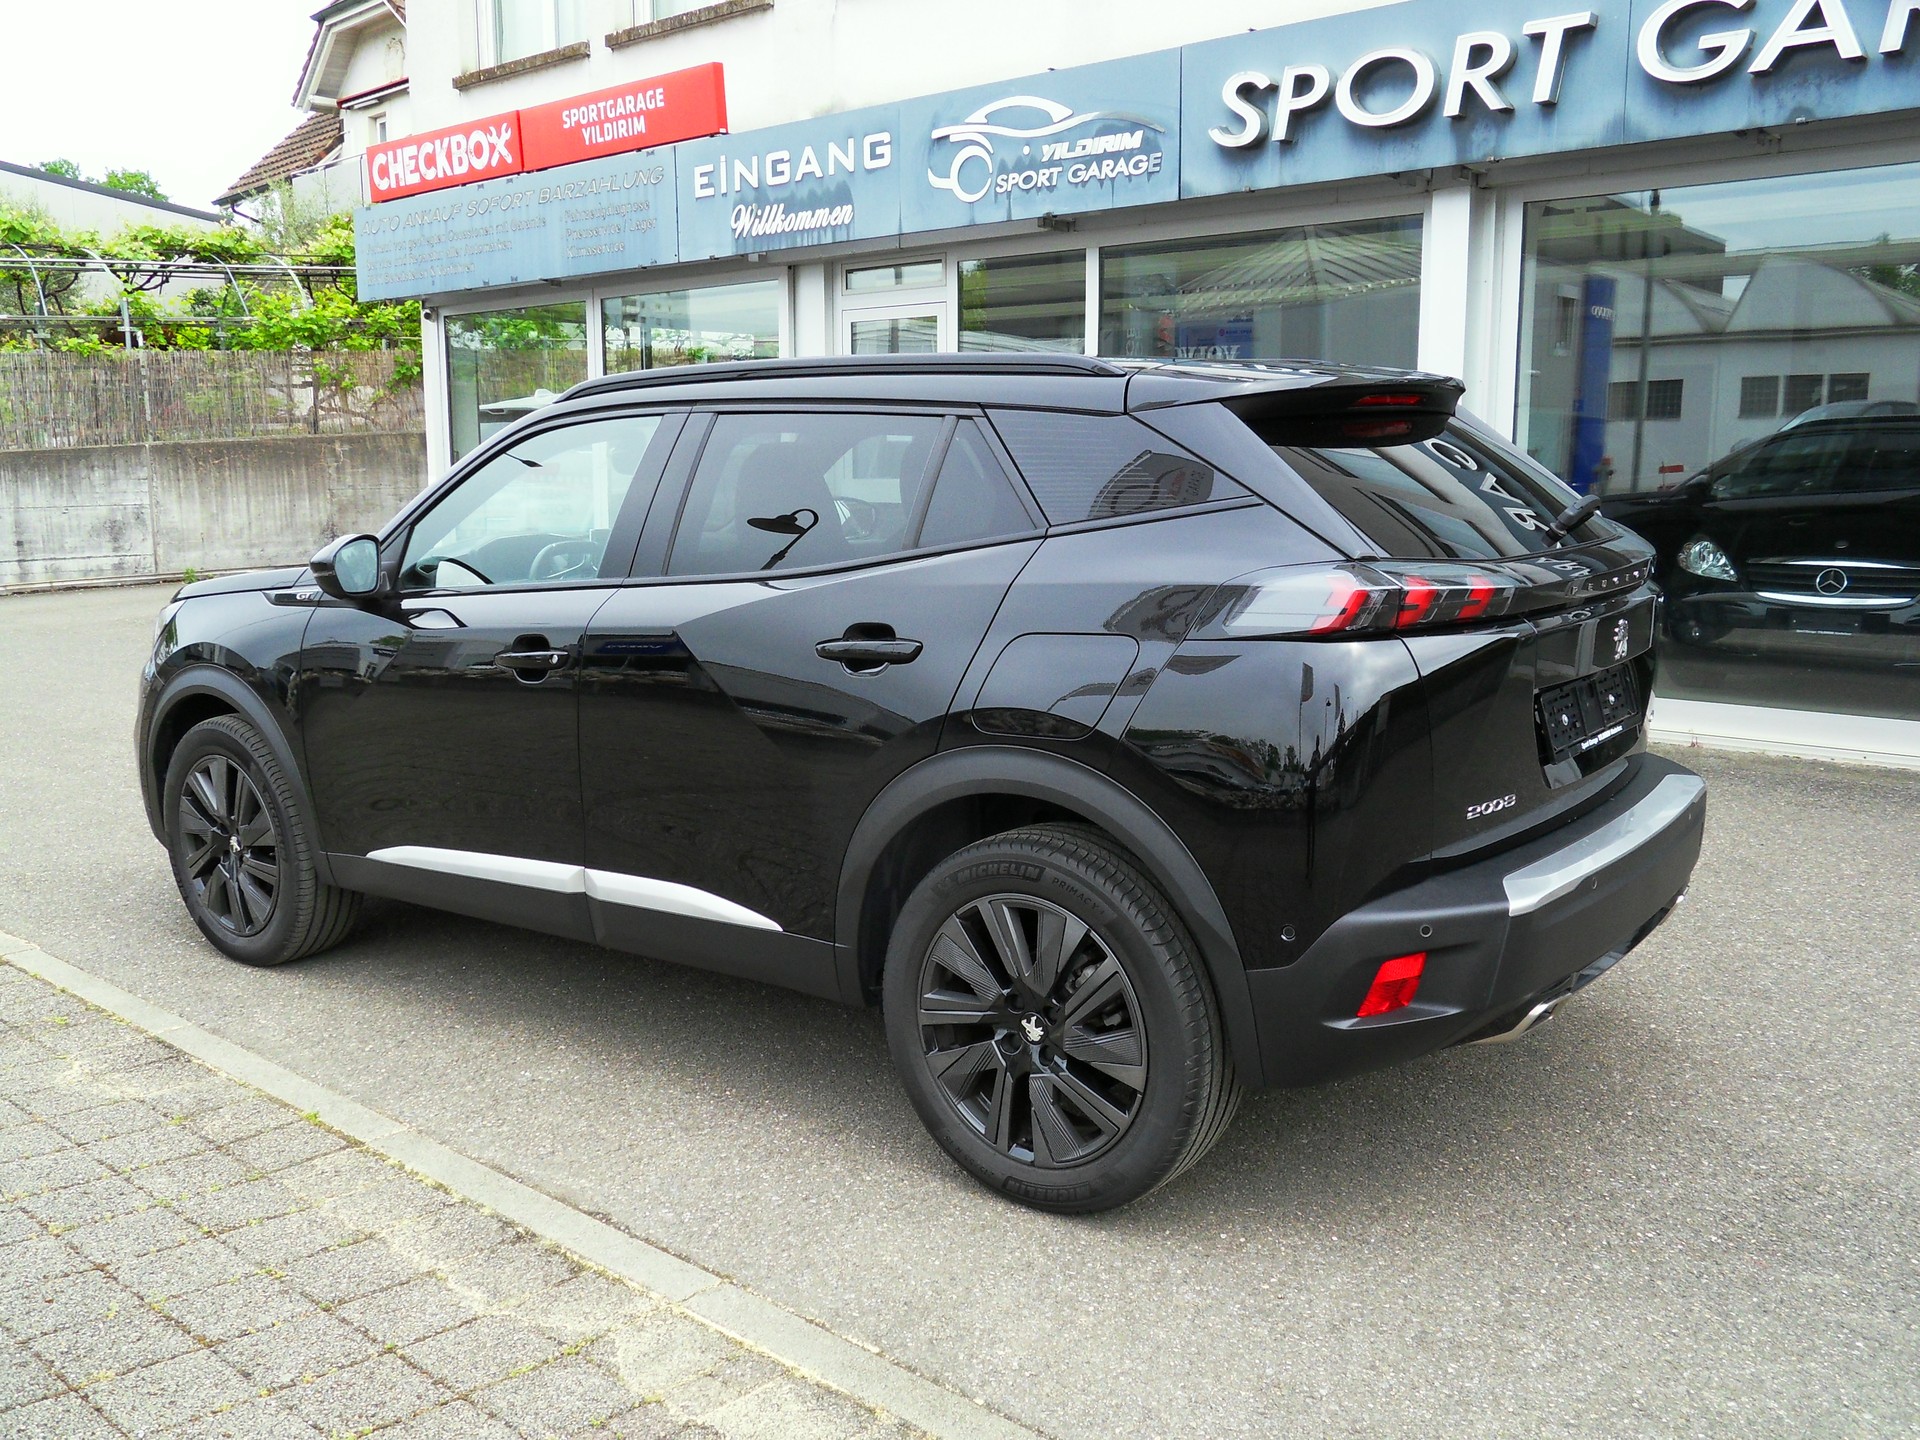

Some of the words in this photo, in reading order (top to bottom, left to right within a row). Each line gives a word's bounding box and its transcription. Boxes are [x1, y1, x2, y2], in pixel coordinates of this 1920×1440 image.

[1208, 11, 1597, 149] SPORT
[562, 87, 665, 129] SPORTGARAGE
[582, 115, 646, 146] YILDIRIM
[1040, 130, 1144, 162] YILDIRIM
[372, 122, 512, 191] CHECKBOX
[996, 165, 1063, 194] SPORT
[1067, 151, 1164, 185] GARAGE
[362, 216, 400, 236] AUTO
[404, 203, 462, 226] ANKAUF
[466, 189, 536, 217] SOFORT
[538, 165, 664, 205] BARZAHLUNG
[629, 217, 657, 234] Lager
[731, 202, 854, 240] Willkommen
[566, 241, 625, 259] Klimaservice
[1466, 794, 1517, 820] 2008
[957, 863, 1040, 886] MICHELIN
[1052, 877, 1099, 910] PRIMACY
